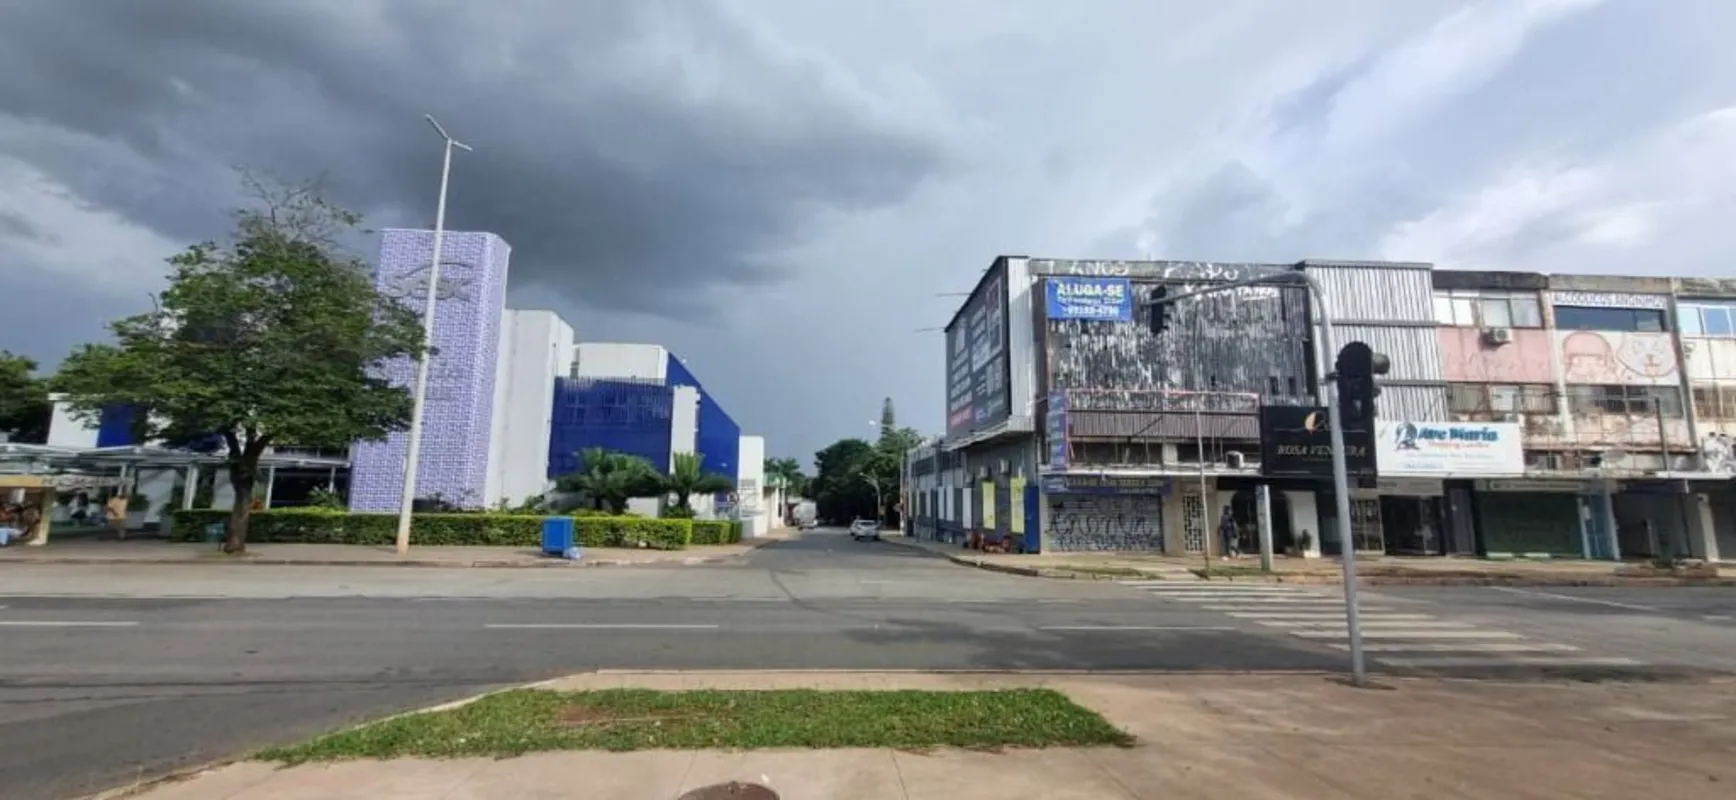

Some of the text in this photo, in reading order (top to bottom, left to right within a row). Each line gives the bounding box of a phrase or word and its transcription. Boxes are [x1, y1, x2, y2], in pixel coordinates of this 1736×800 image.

[1057, 283, 1125, 298] ALUGA-SE
[1418, 426, 1498, 441] Ave Maria
[1277, 444, 1366, 457] ROSA VENURA
